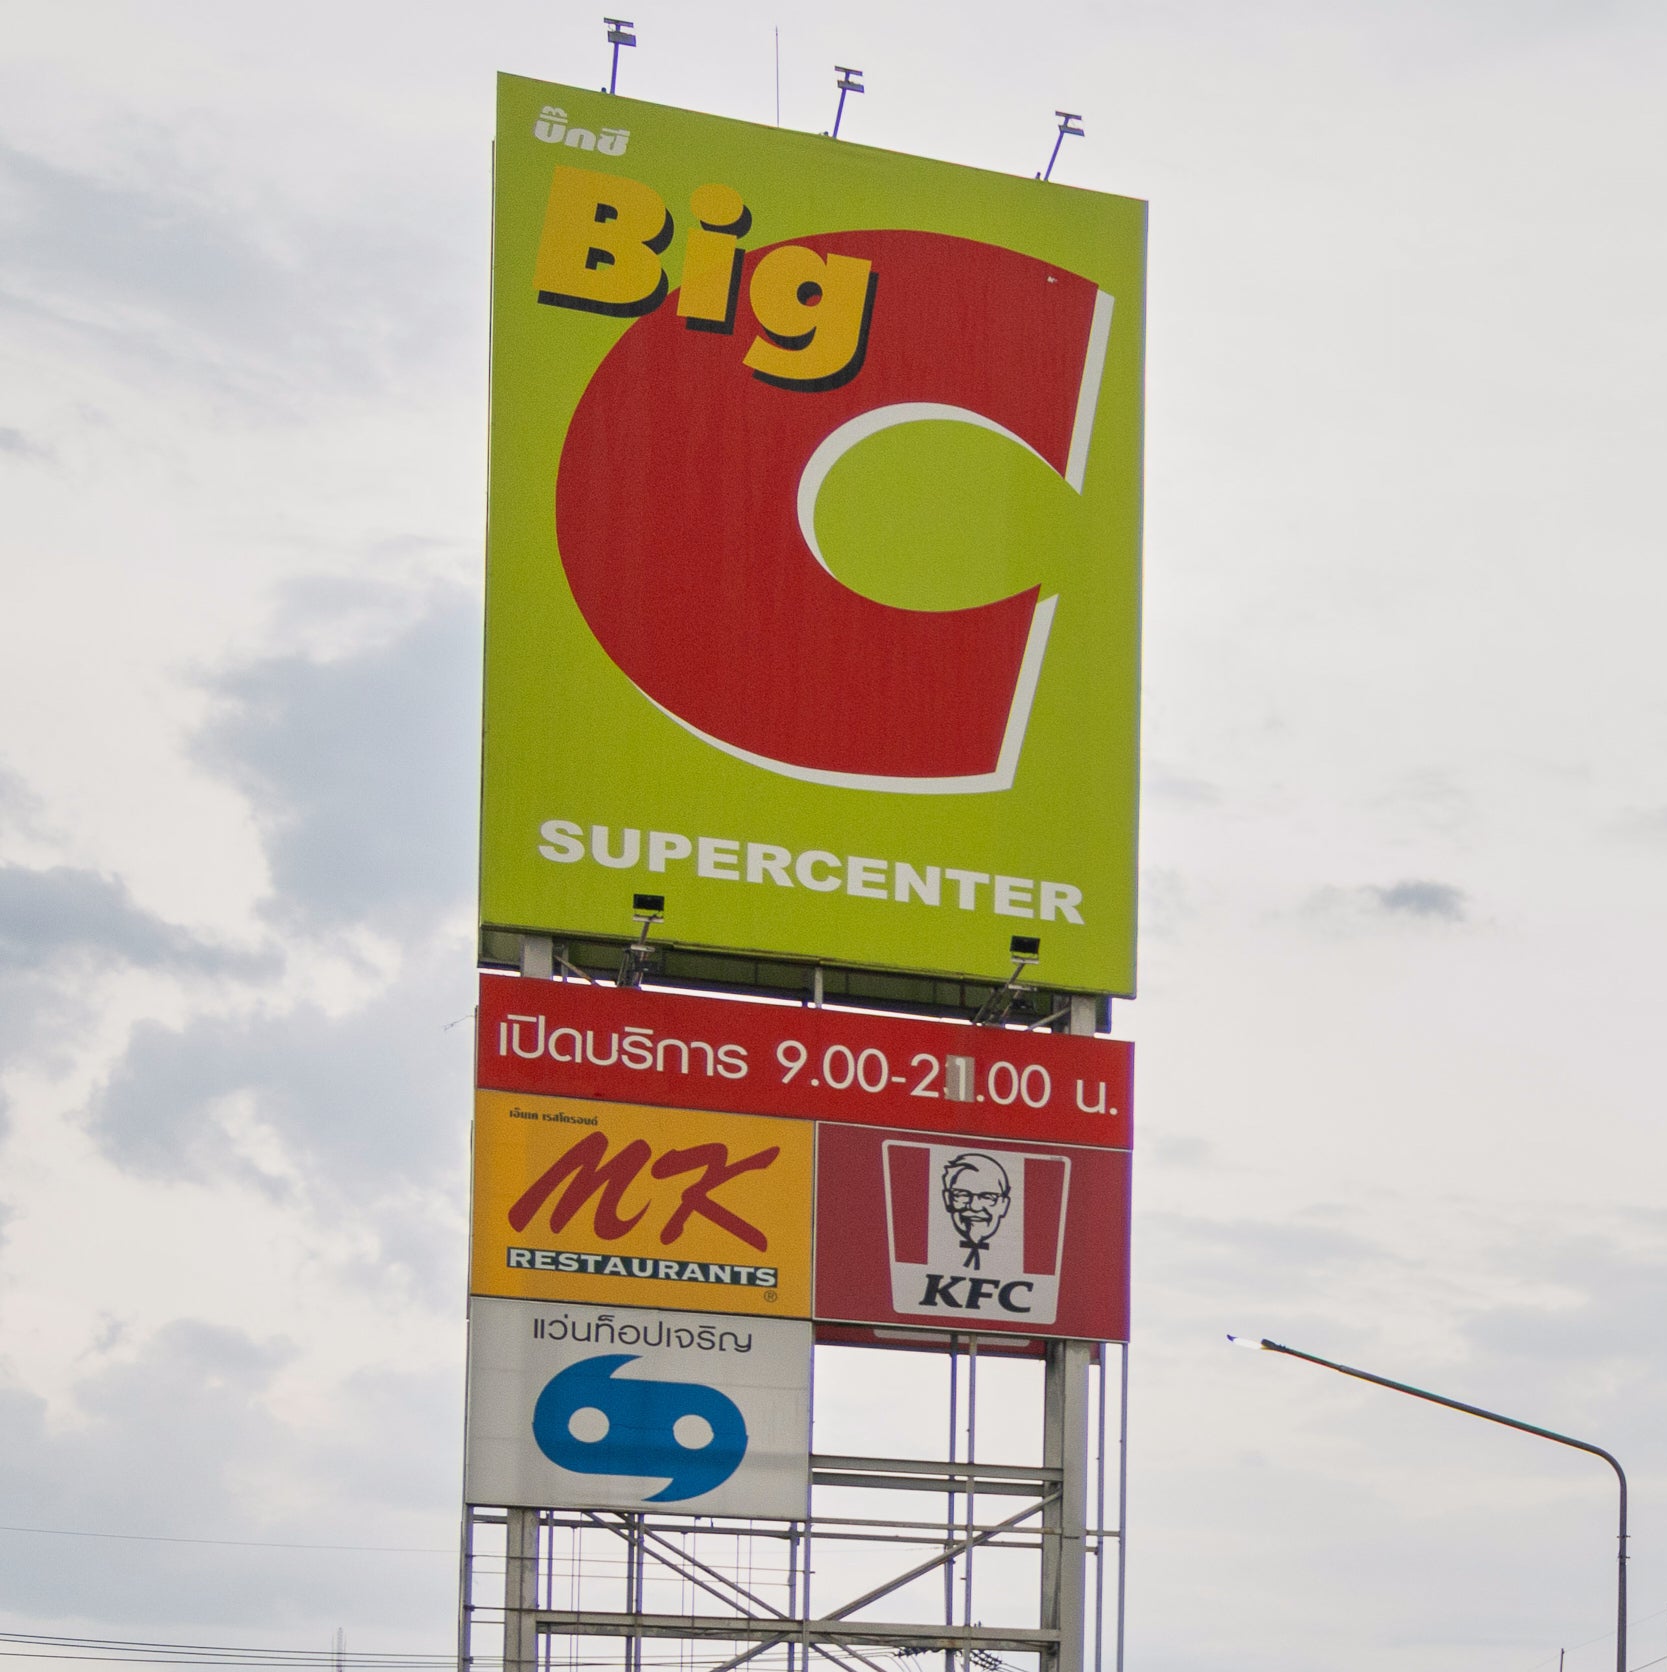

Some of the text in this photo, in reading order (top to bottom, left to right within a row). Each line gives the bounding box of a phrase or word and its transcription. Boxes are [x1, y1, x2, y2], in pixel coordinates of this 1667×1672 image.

[532, 105, 630, 158] บิ๊กซี
[533, 164, 1114, 795] Big C
[537, 819, 1086, 925] SUPERCENTER
[499, 1014, 1118, 1116] เปิดบริการ 9.00-21.00 น.
[507, 1131, 781, 1253] MK
[508, 1248, 777, 1287] RESTAURANTS
[918, 1274, 1034, 1313] KFC
[533, 1314, 752, 1353] แว่นท็อปเจริญ
